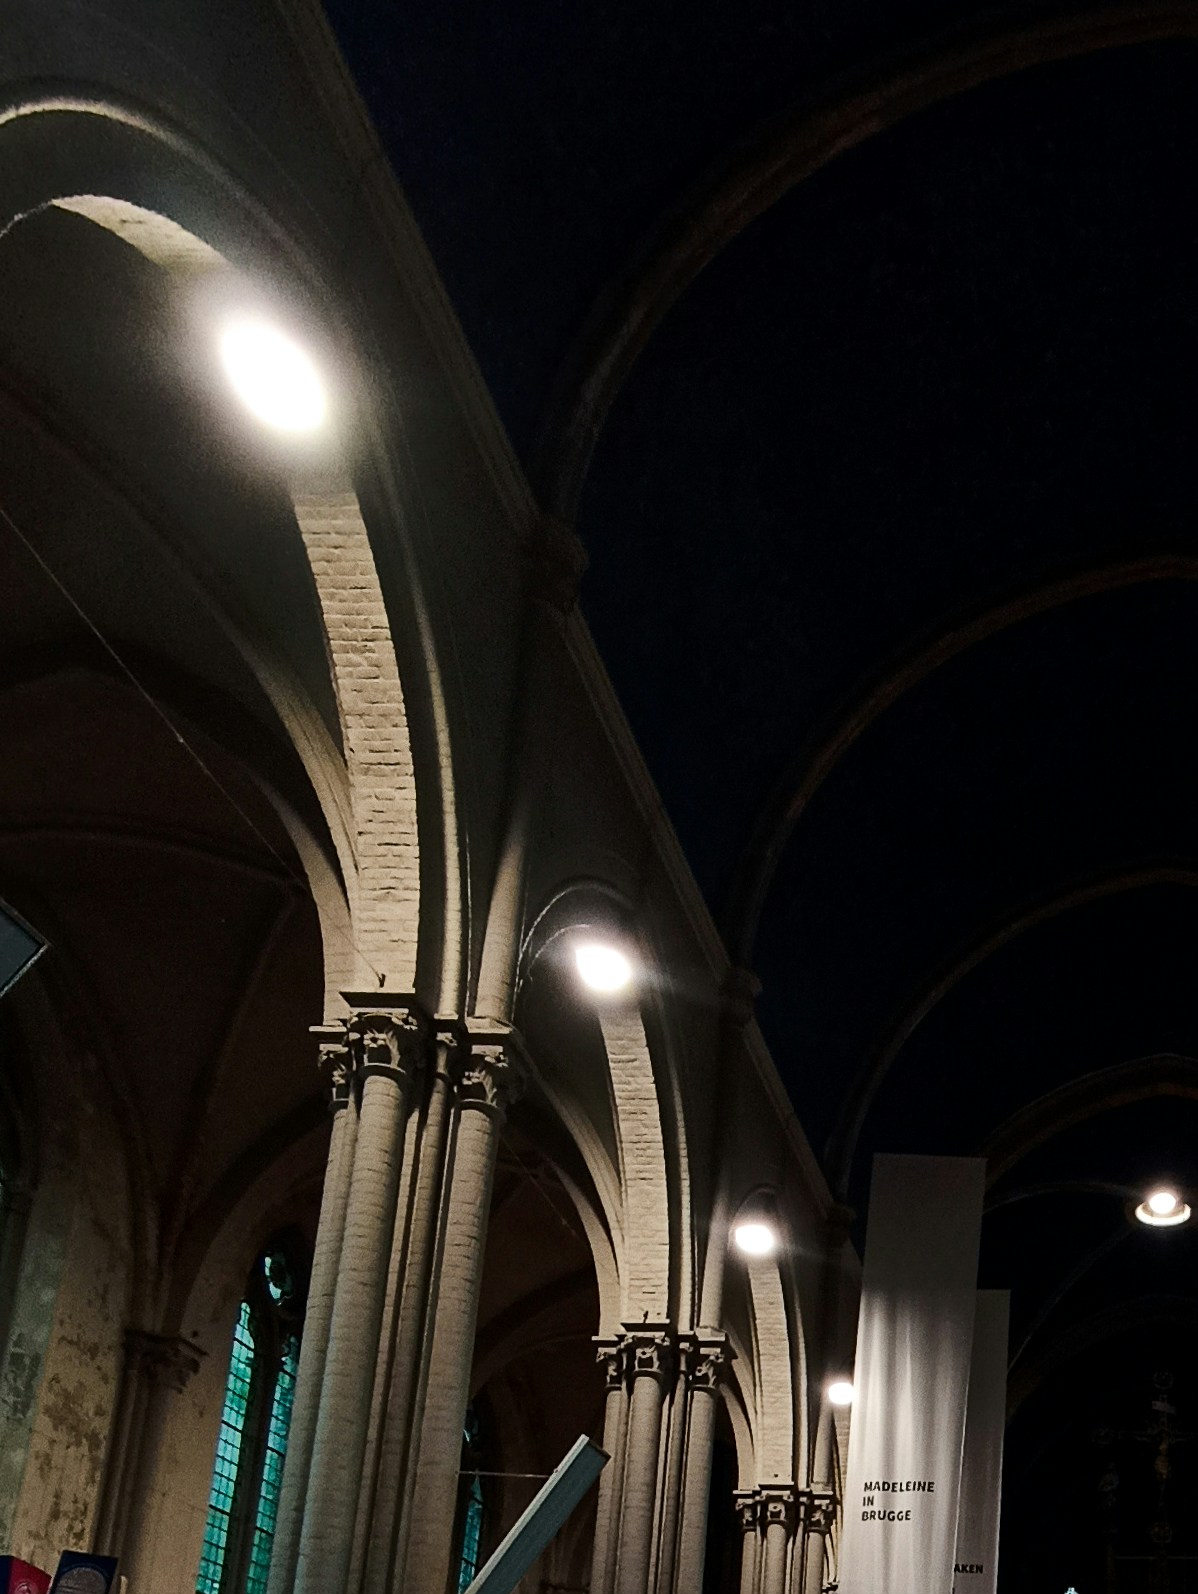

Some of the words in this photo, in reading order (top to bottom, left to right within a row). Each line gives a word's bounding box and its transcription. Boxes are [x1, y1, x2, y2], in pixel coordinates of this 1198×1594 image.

[863, 1481, 934, 1492] MADELEINE
[862, 1495, 874, 1506] IN
[861, 1510, 911, 1521] BRUGGE
